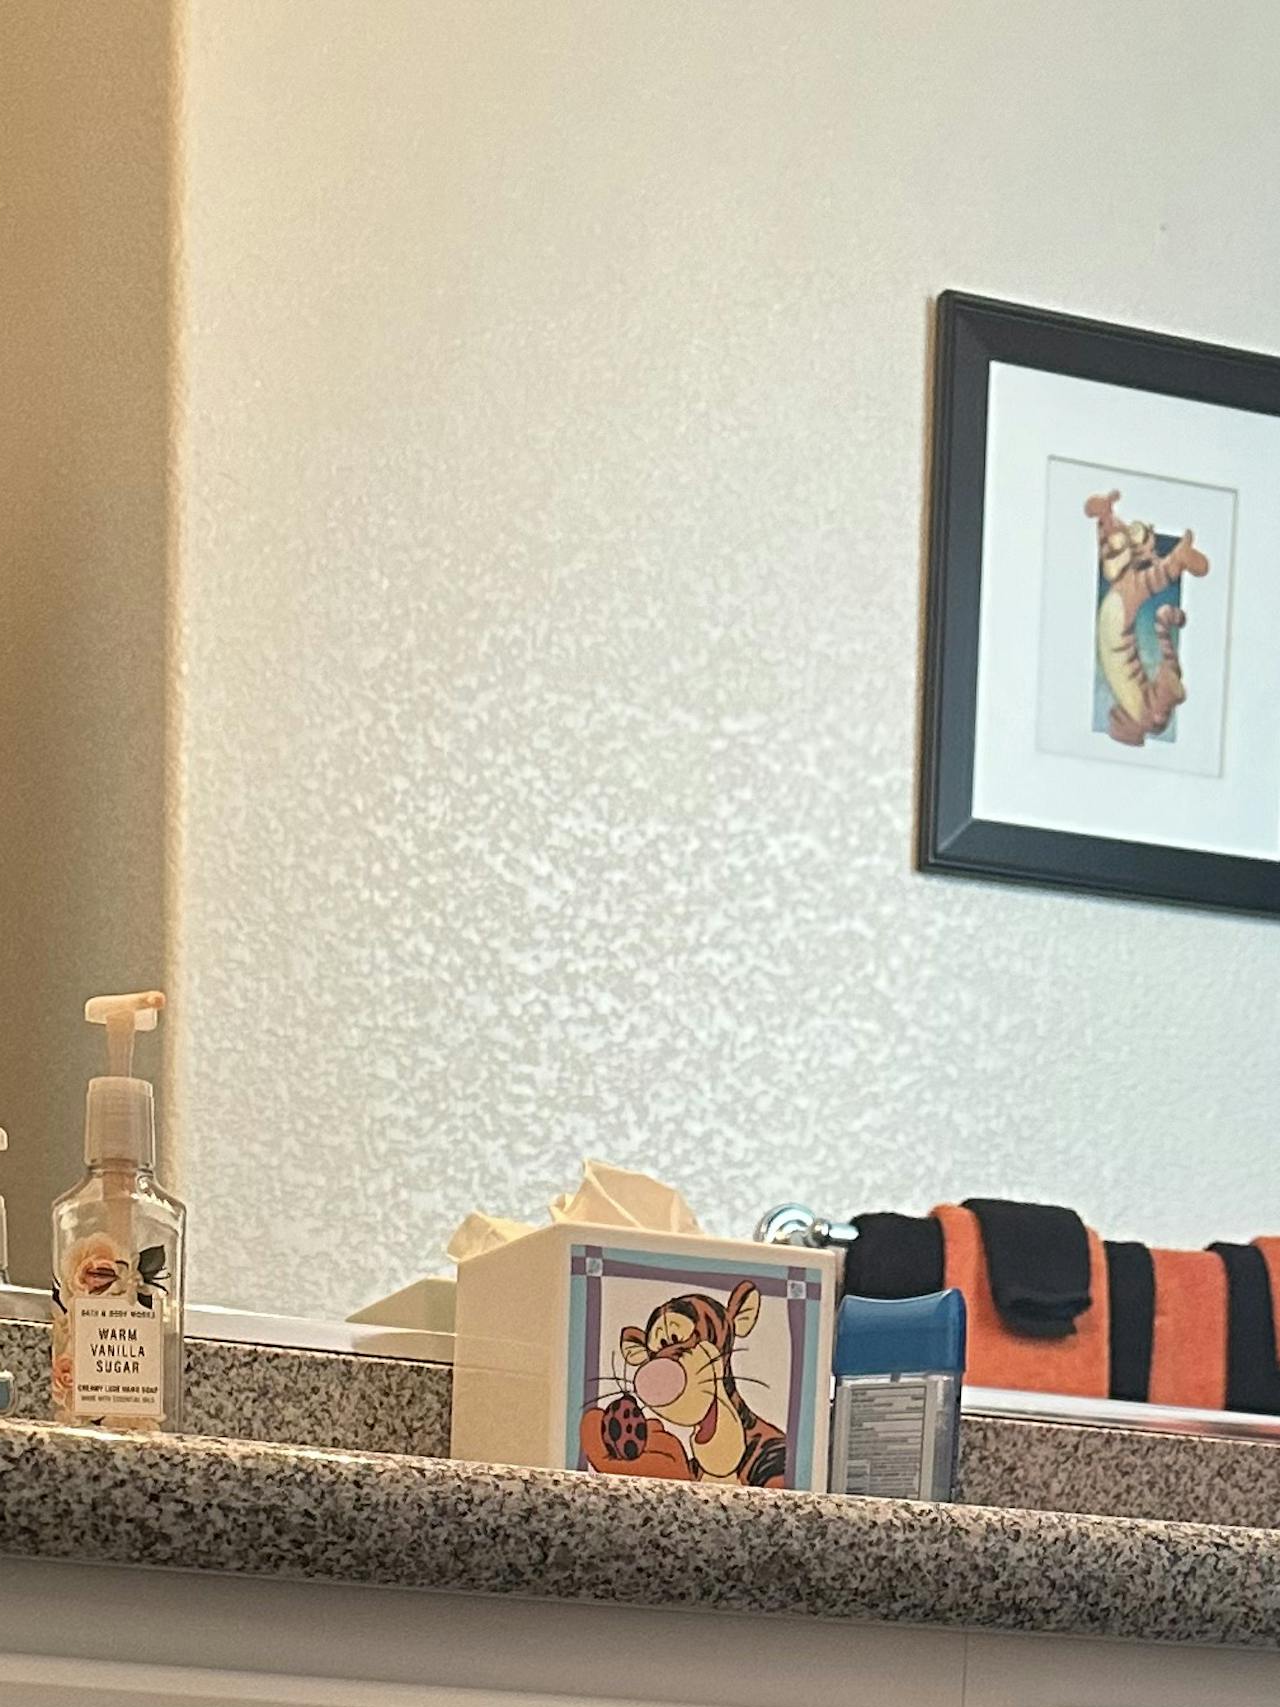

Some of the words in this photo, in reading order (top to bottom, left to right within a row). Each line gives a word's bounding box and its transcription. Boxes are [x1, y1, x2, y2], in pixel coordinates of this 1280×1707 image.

[98, 1328, 137, 1341] WARM
[90, 1344, 145, 1358] VANILLA
[96, 1360, 140, 1374] SUGAR
